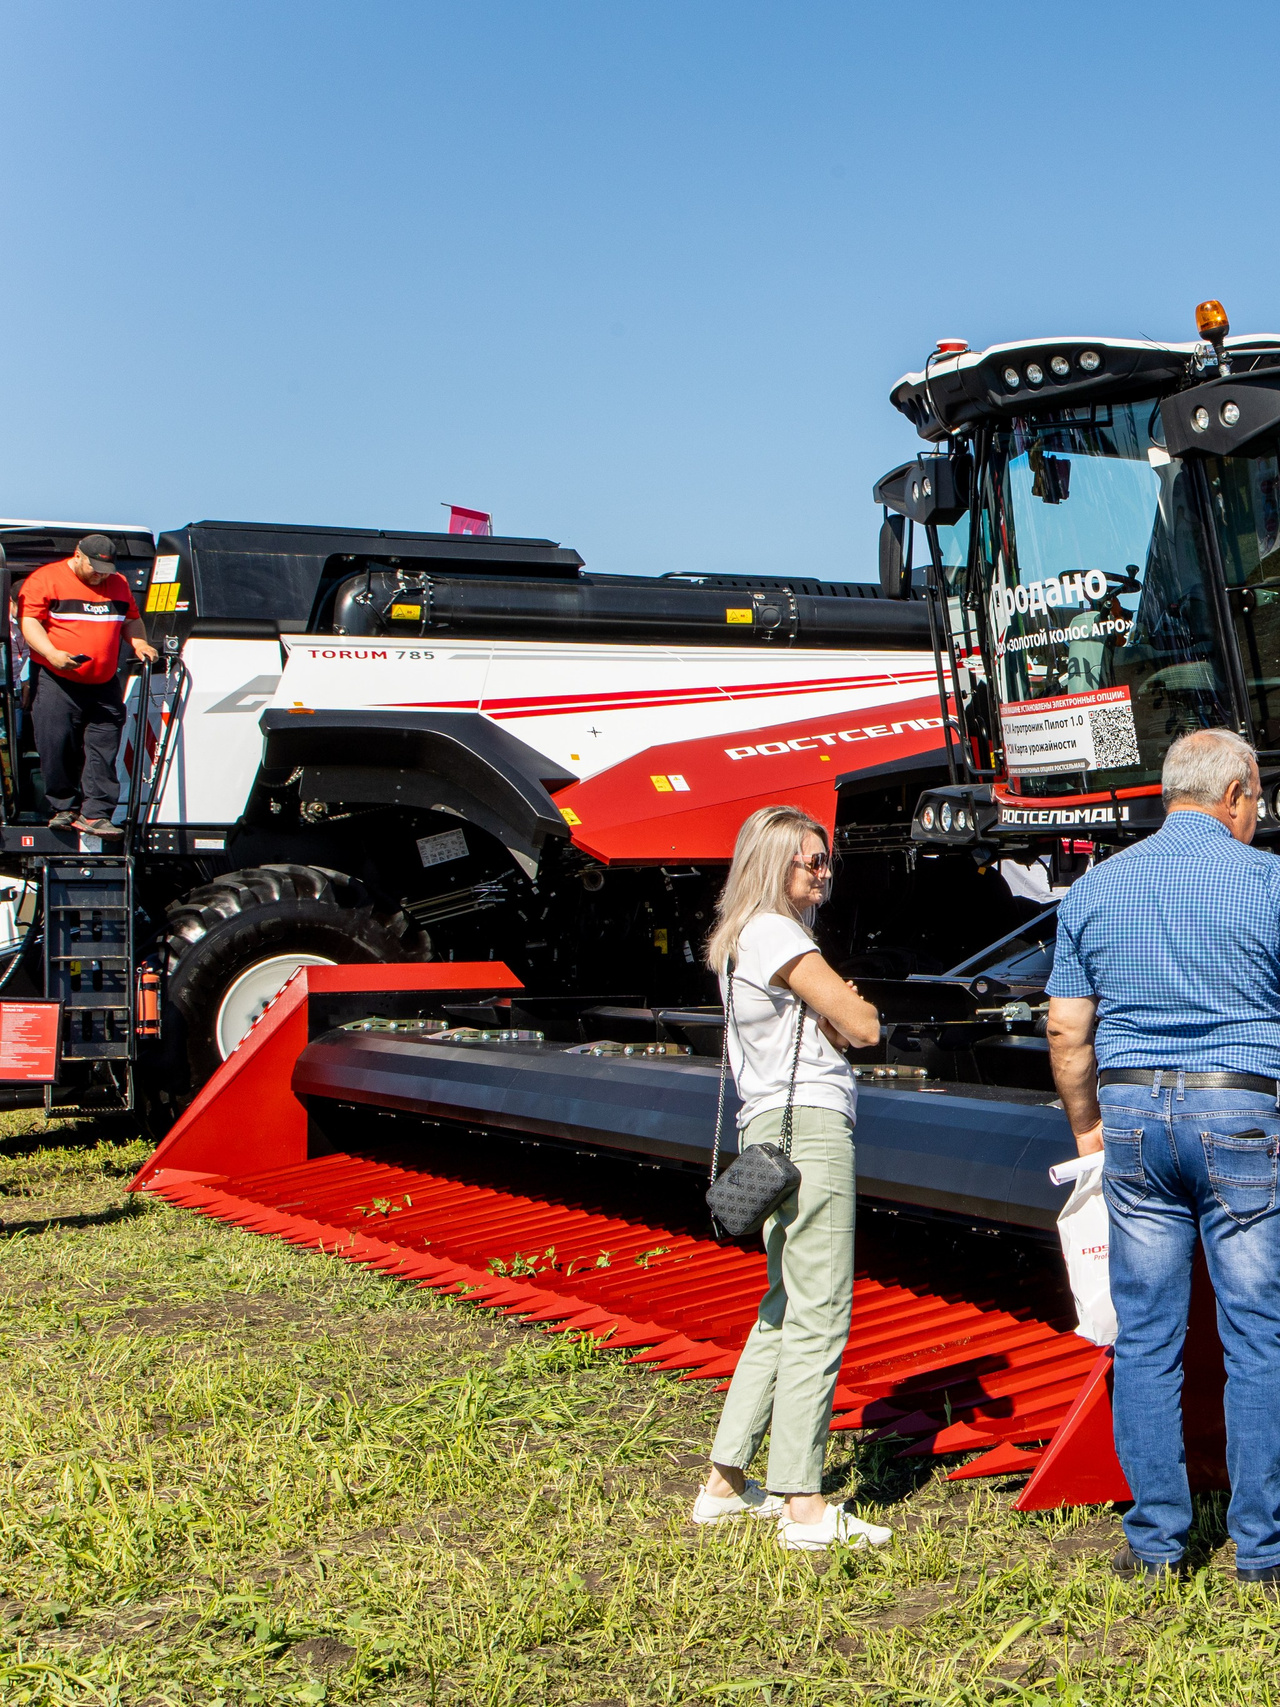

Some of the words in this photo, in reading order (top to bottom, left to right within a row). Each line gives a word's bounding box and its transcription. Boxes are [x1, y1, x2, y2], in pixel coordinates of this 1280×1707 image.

[991, 569, 1108, 627] Продано
[83, 602, 110, 614] Kappa
[1006, 628, 1048, 653] «ЗОЛОТОЙ
[1049, 624, 1088, 645] КОЛОС
[1091, 617, 1135, 638] АГРО»
[308, 649, 388, 660] TORUM
[395, 650, 436, 660] 785
[1052, 695, 1096, 709] ЭЛЕКТРОННЫЕ
[1096, 690, 1125, 701] ОПЦИИ:
[1044, 718, 1069, 731] Пилот
[1069, 715, 1084, 727] 1.0
[724, 714, 959, 761] РОСТСЕЛЬ
[1014, 743, 1028, 757] Карта
[1028, 739, 1077, 756] урожайности
[1002, 806, 1130, 825] РОСТСЕЛЬМАШ
